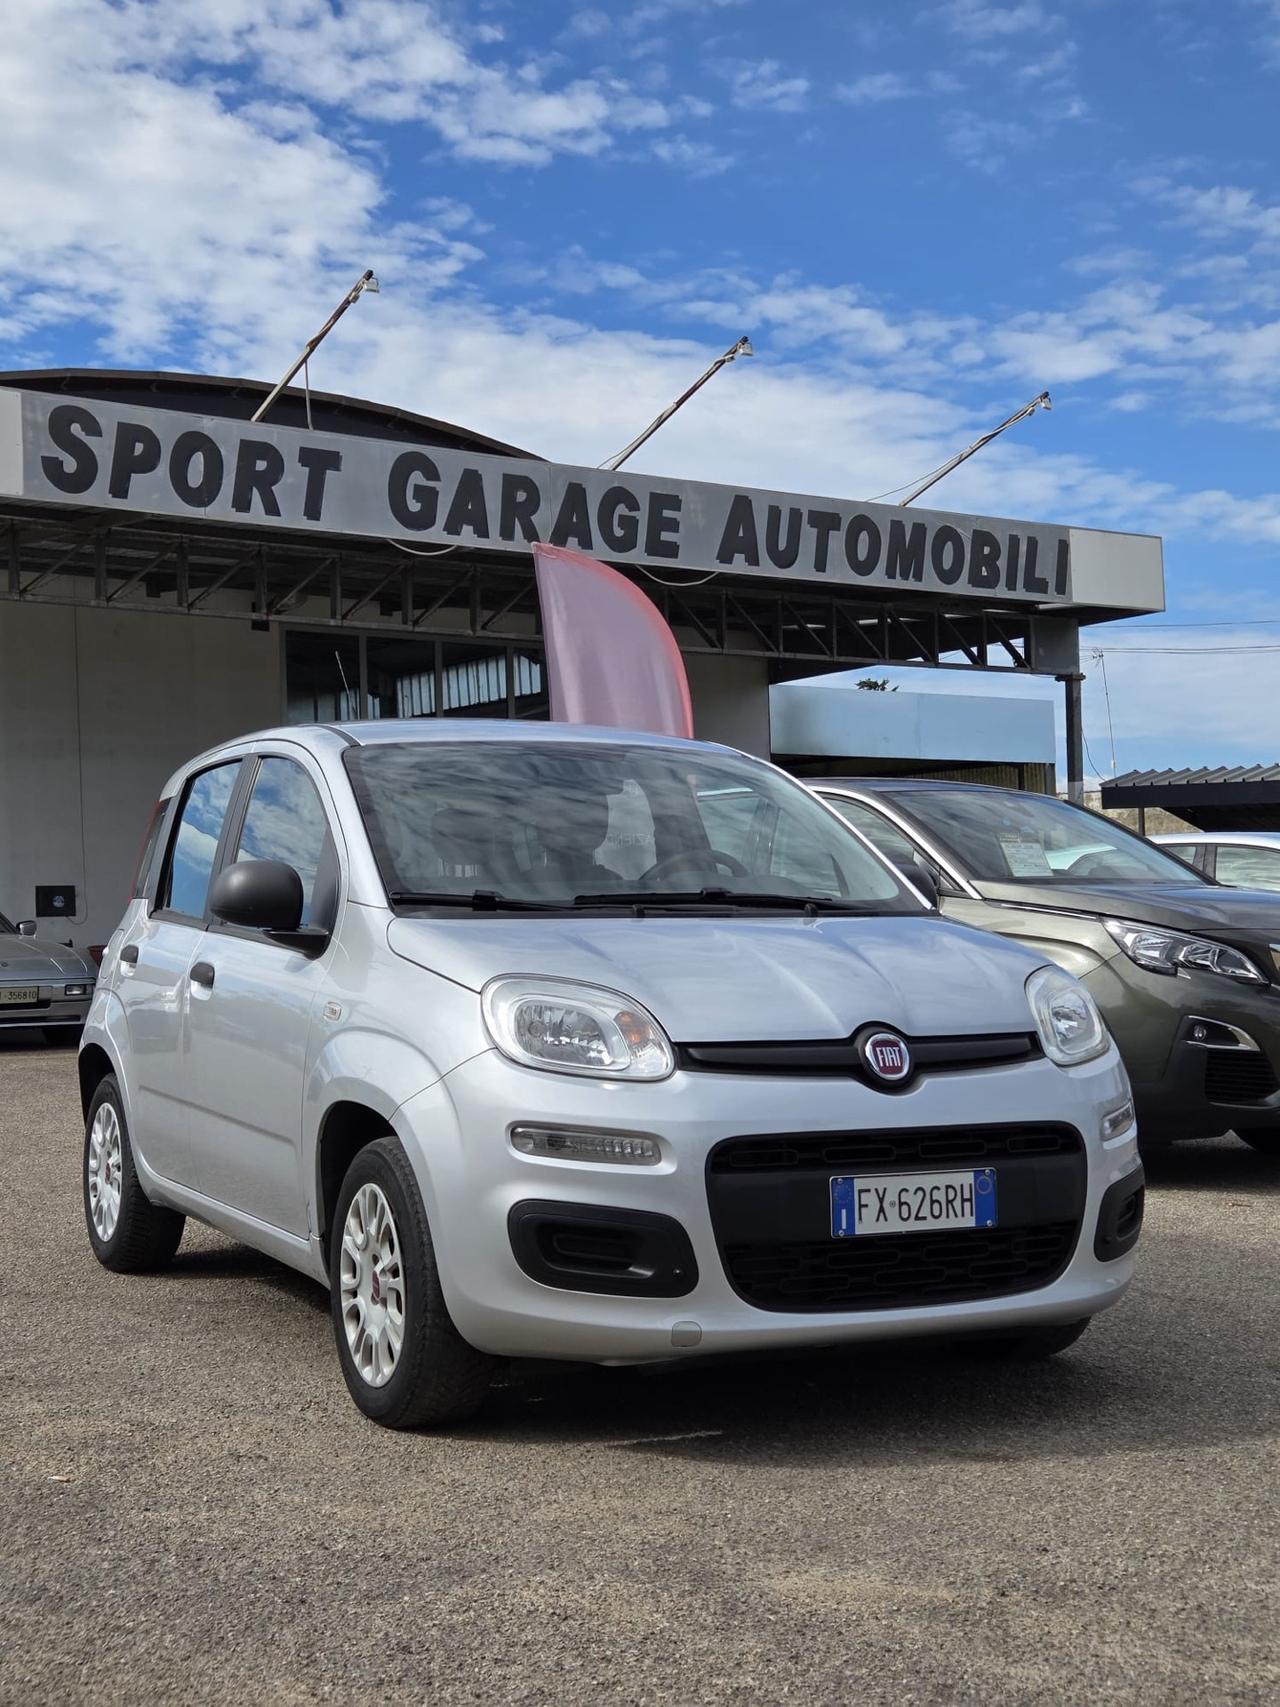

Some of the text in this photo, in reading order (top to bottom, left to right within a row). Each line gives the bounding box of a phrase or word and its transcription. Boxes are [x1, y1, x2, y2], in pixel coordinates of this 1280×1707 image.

[41, 404, 1070, 596] SPORT GARAGE AUTOMOBILI
[875, 1046, 902, 1068] FIAT
